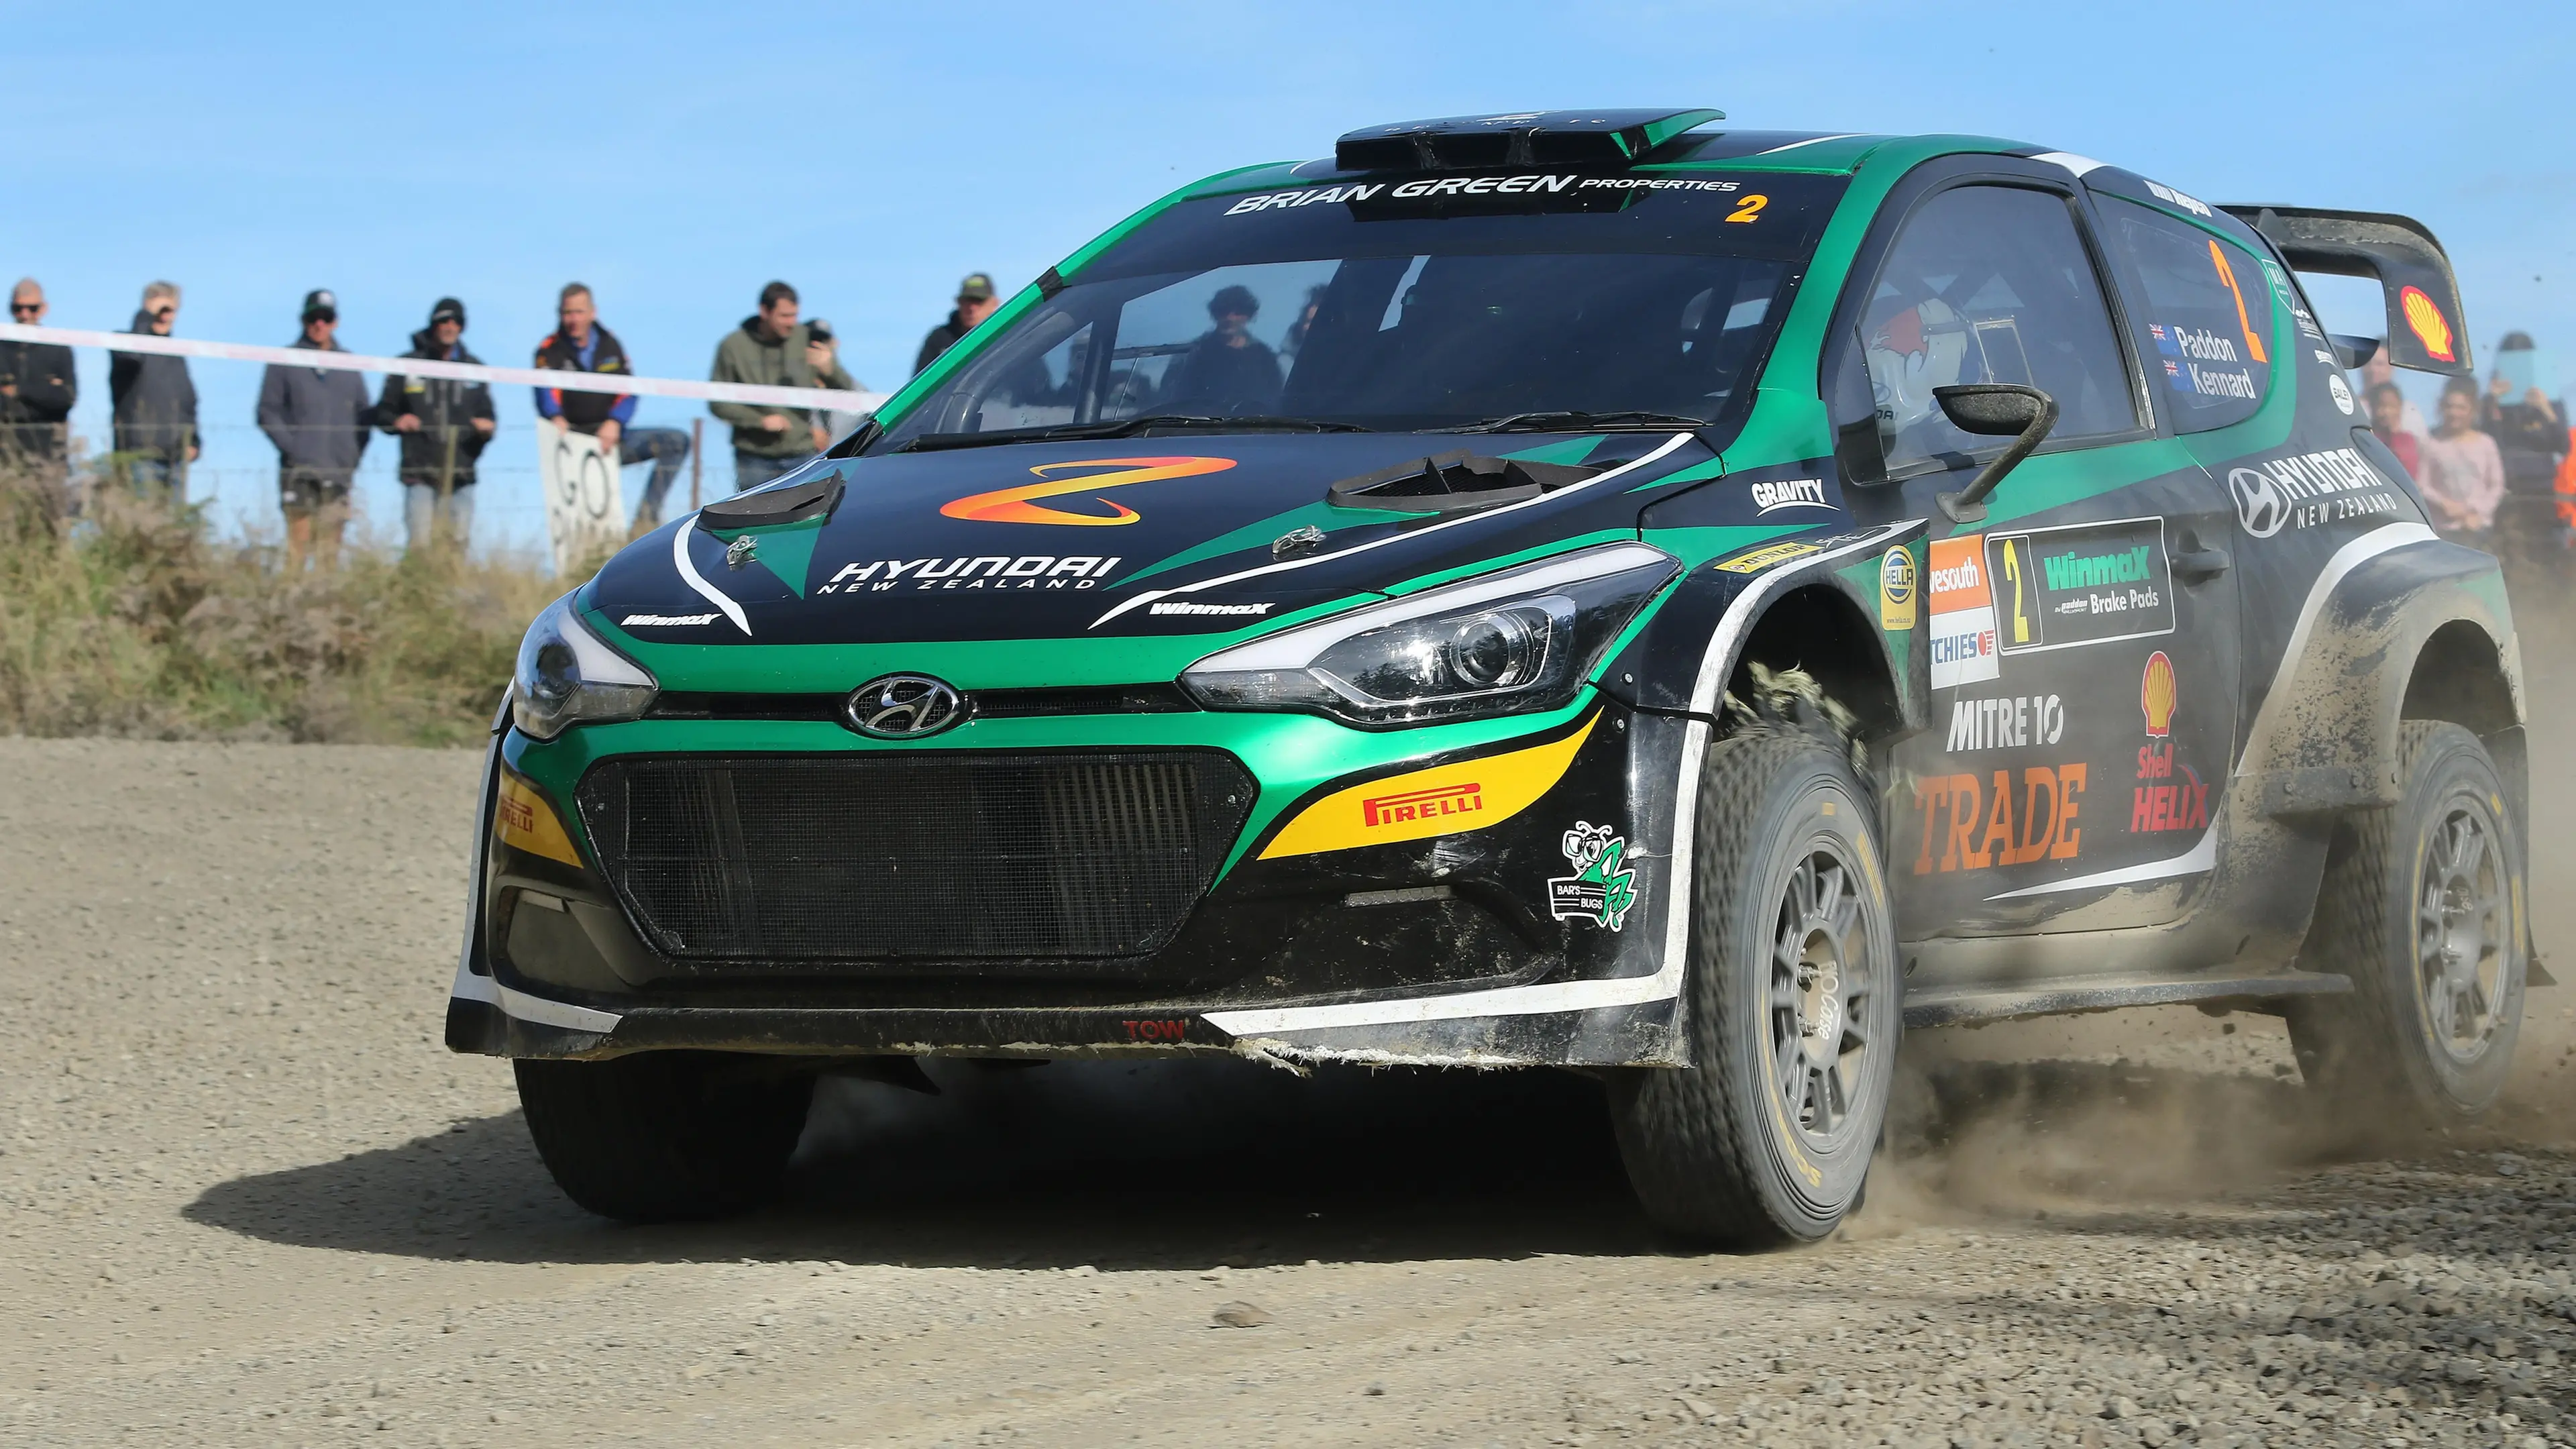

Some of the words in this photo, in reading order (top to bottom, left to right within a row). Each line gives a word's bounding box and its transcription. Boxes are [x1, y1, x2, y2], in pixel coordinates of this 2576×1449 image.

[1224, 183, 1386, 216] BRIAN
[1392, 174, 1578, 198] GREEN
[1578, 178, 1741, 193] PROPERTIES
[1725, 194, 1768, 223] 2
[2208, 239, 2268, 363] 2
[2174, 326, 2238, 362] Paddon
[2188, 362, 2256, 399] Kennard
[554, 439, 610, 520] GO
[2263, 447, 2383, 500] HYUNDAI
[1752, 479, 1826, 508] GRAVITY
[2297, 502, 2330, 529] NEW
[2337, 492, 2398, 520] ZEALAND
[816, 581, 900, 594] NEW
[916, 579, 1097, 590] ZEALAND
[829, 556, 1122, 583] HYUNDAI
[1886, 568, 1913, 586] HELLA
[2003, 539, 2029, 643] 2
[2090, 590, 2127, 614] Brake
[2129, 586, 2159, 609] Pads
[1946, 696, 2027, 752] MITRE
[2034, 694, 2064, 745] 10
[2136, 743, 2173, 779] Shell
[1362, 783, 1483, 827] PIRELLI
[1914, 762, 2087, 875] TRADE
[2131, 783, 2209, 833] HELIX
[1557, 885, 1580, 896] BAR'S
[1580, 898, 1603, 910] BUGS
[1122, 1020, 1184, 1040] TOW
